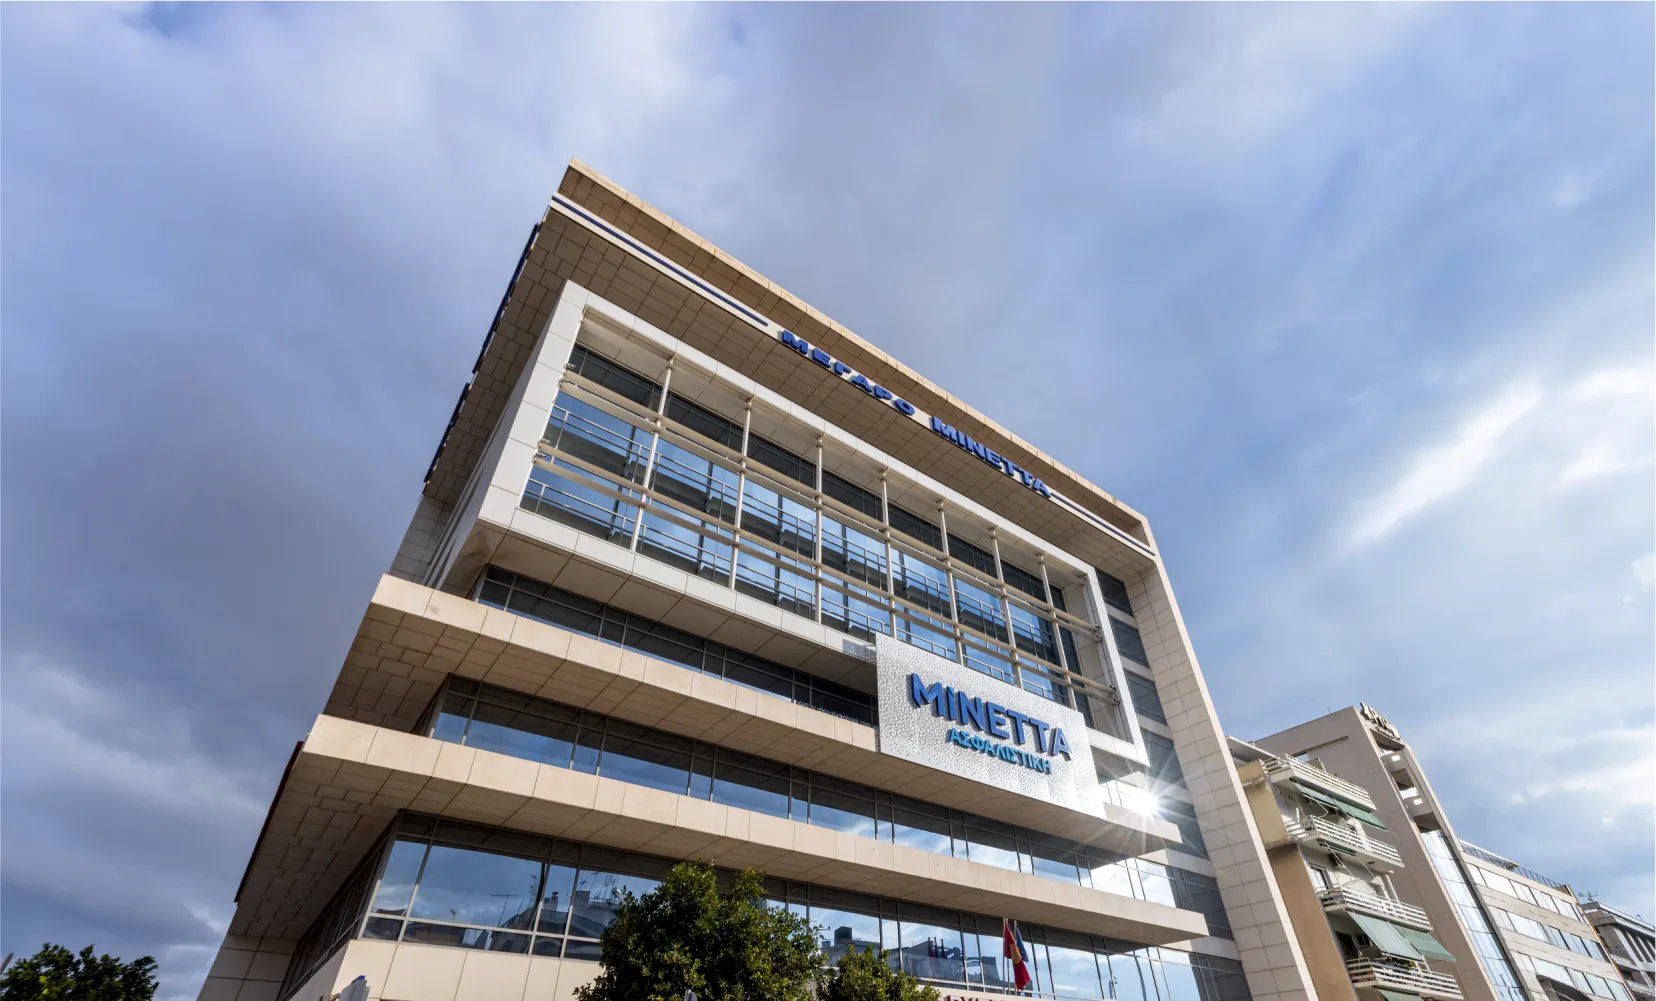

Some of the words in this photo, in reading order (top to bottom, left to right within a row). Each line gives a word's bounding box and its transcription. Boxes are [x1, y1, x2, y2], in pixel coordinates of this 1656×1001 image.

[781, 329, 916, 416] ΜΕΓΑΡΟ
[931, 415, 1051, 498] MINETTA
[910, 672, 1072, 758] MINETTA
[948, 727, 1052, 774] ΑΣΦΑΛΙΣΤΙΚΗ
